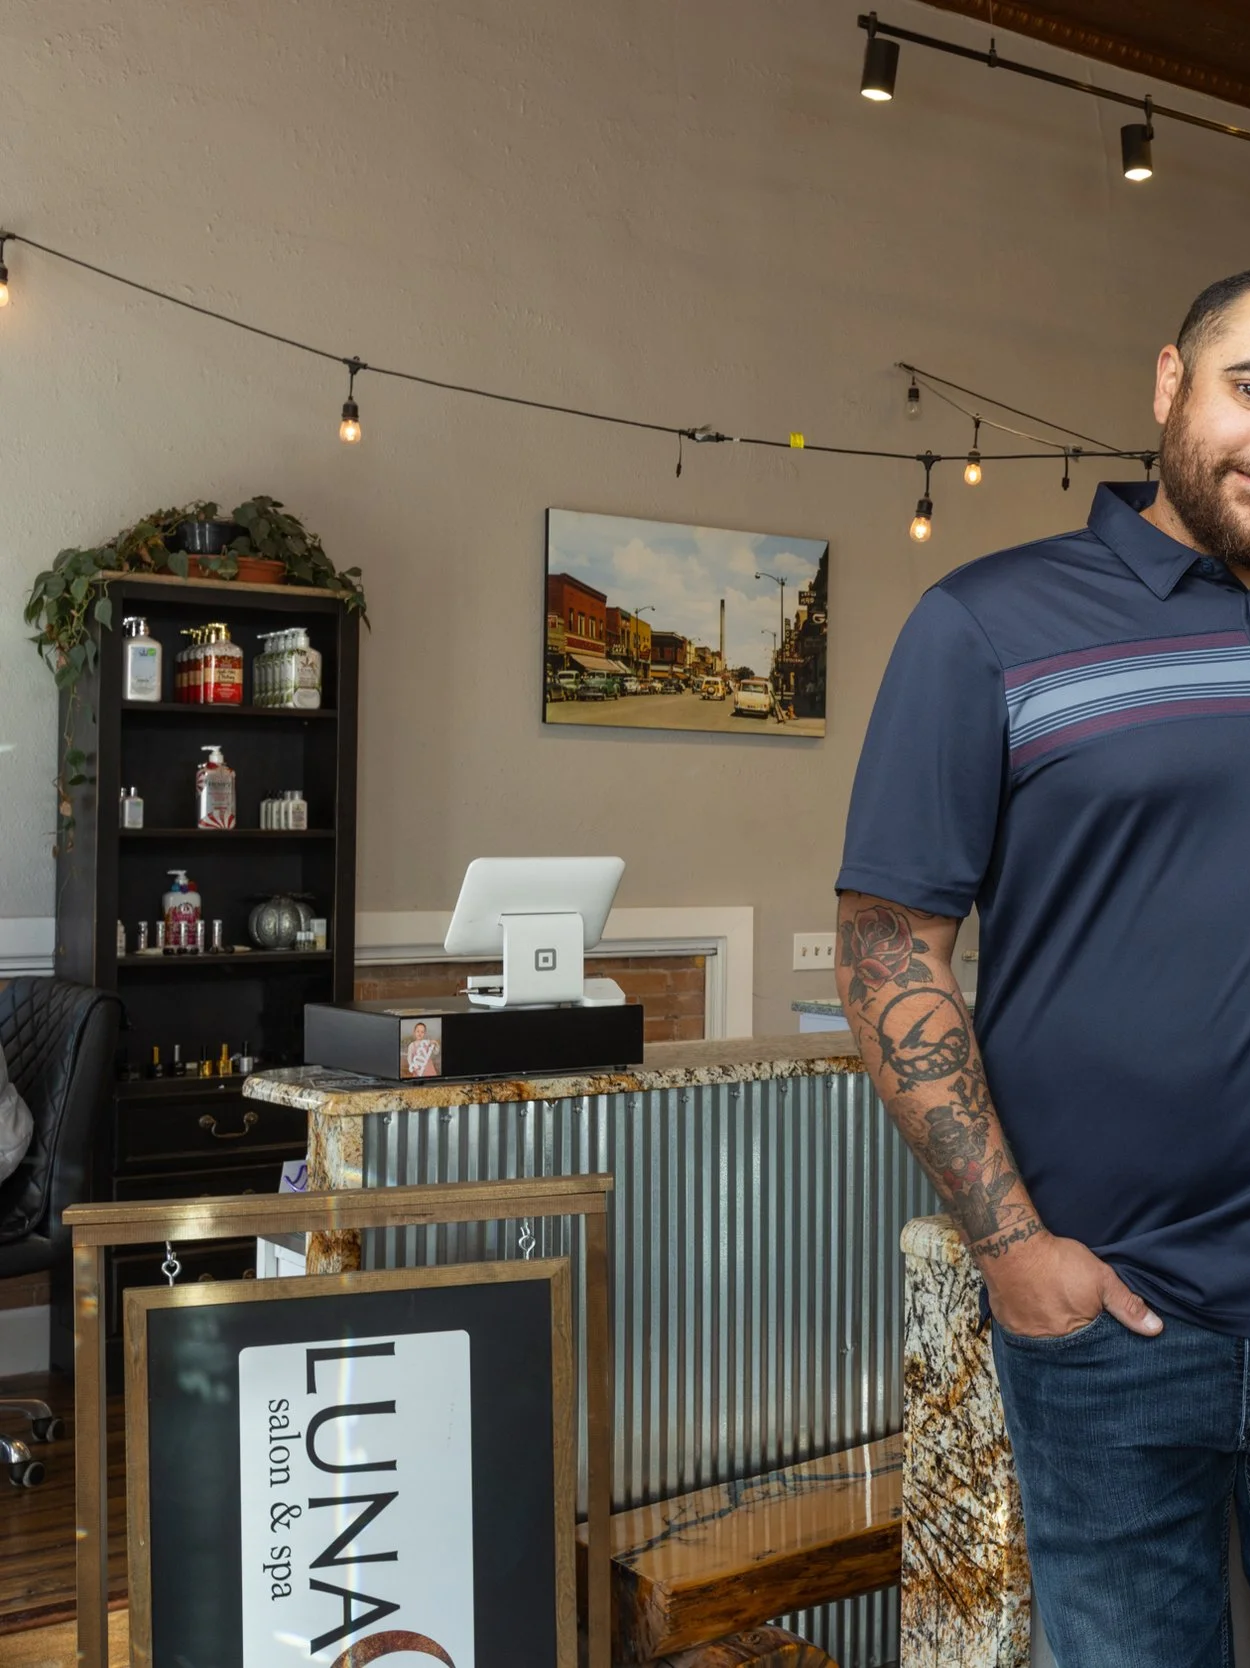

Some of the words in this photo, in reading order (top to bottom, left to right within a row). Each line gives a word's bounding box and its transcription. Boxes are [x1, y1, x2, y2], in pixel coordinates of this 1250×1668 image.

[268, 1398, 302, 1488] salon
[269, 1502, 302, 1533] &
[263, 1545, 292, 1601] spa
